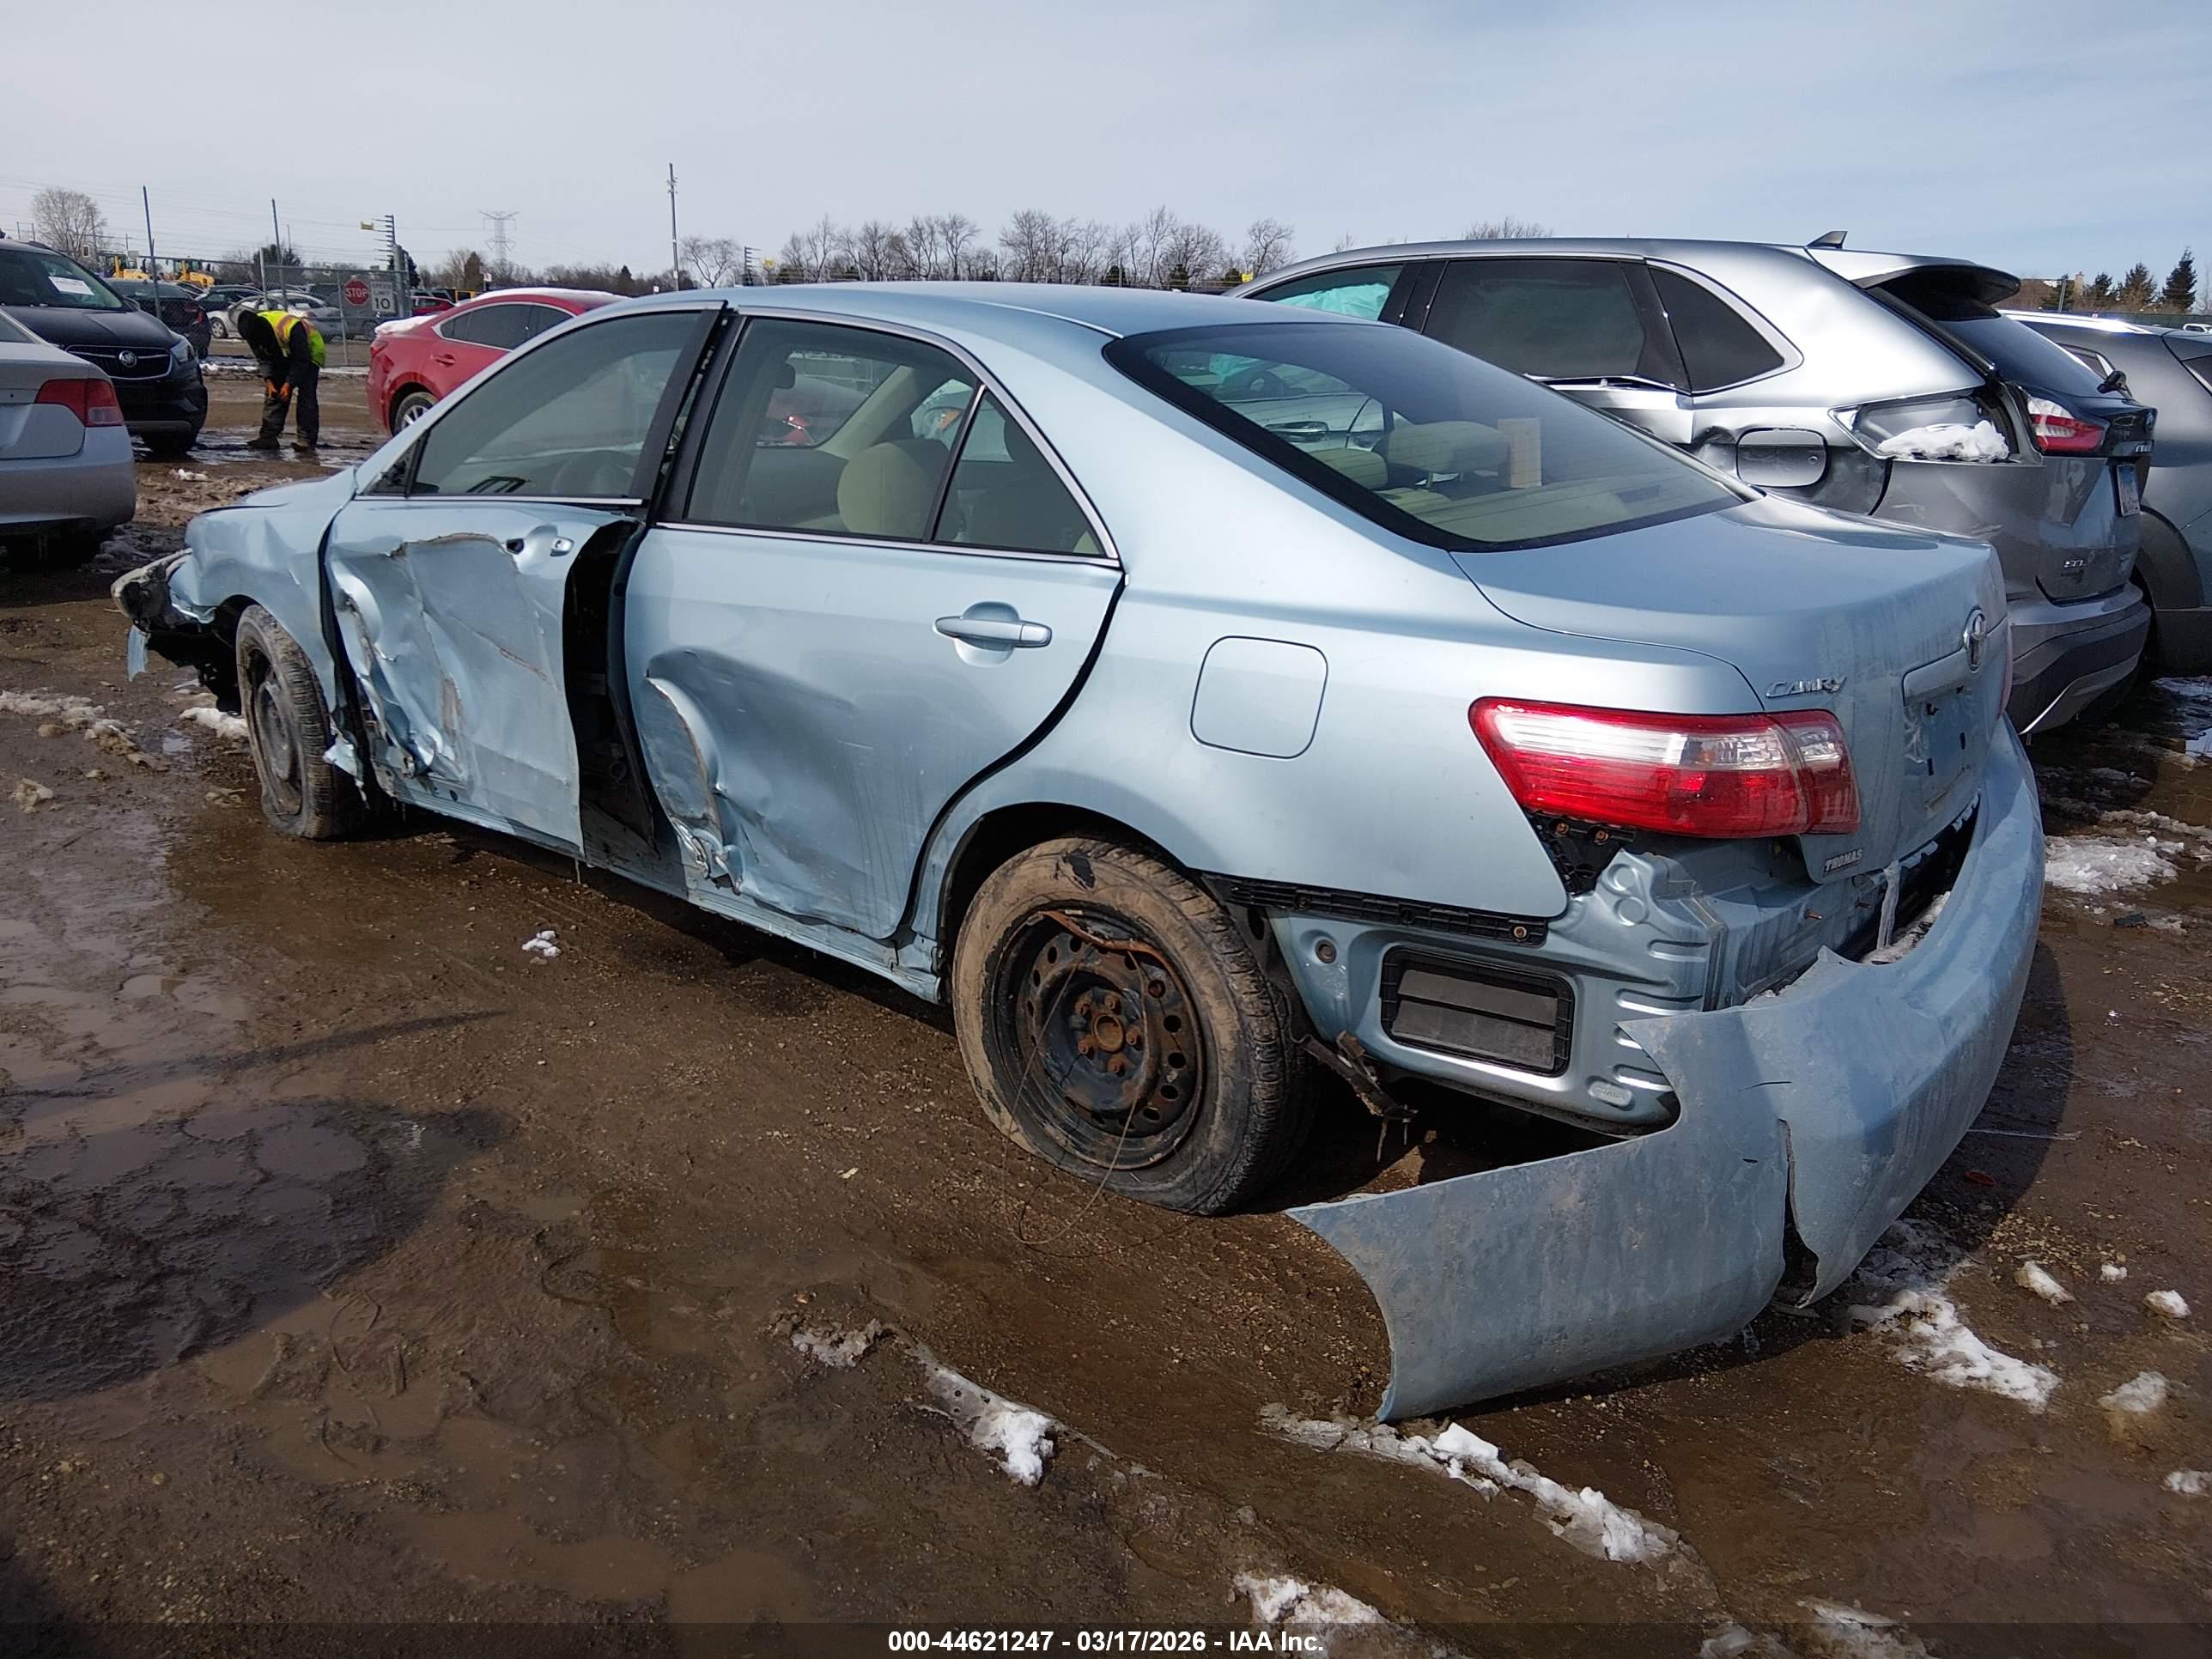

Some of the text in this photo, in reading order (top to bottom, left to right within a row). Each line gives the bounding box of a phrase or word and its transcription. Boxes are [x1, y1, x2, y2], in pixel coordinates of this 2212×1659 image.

[345, 288, 368, 298] STOP
[374, 297, 391, 310] 10
[1765, 675, 1848, 699] CAMRY
